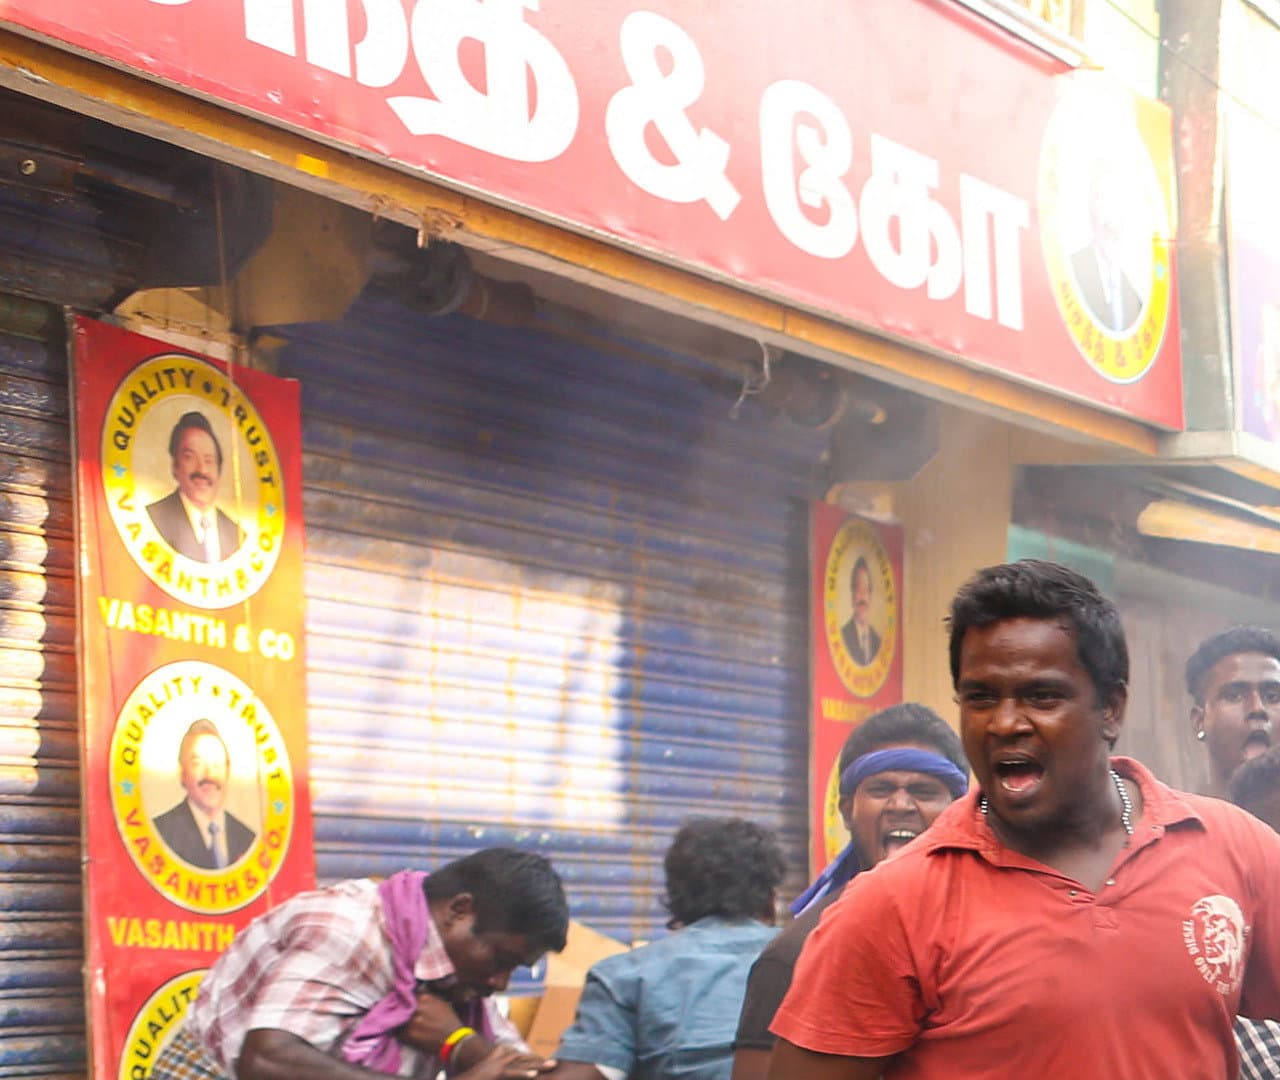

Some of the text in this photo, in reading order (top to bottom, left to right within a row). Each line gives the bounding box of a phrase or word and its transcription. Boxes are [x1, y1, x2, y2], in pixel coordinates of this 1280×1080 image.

[760, 79, 1029, 330] கோ
[114, 368, 274, 488] QUALITY TRUST
[117, 493, 231, 598] VASANTH
[98, 596, 297, 660] VASANTH & CO
[123, 676, 284, 784] QUALITY TRUST
[123, 808, 240, 906] VASANTH
[107, 916, 235, 953] VASANTH
